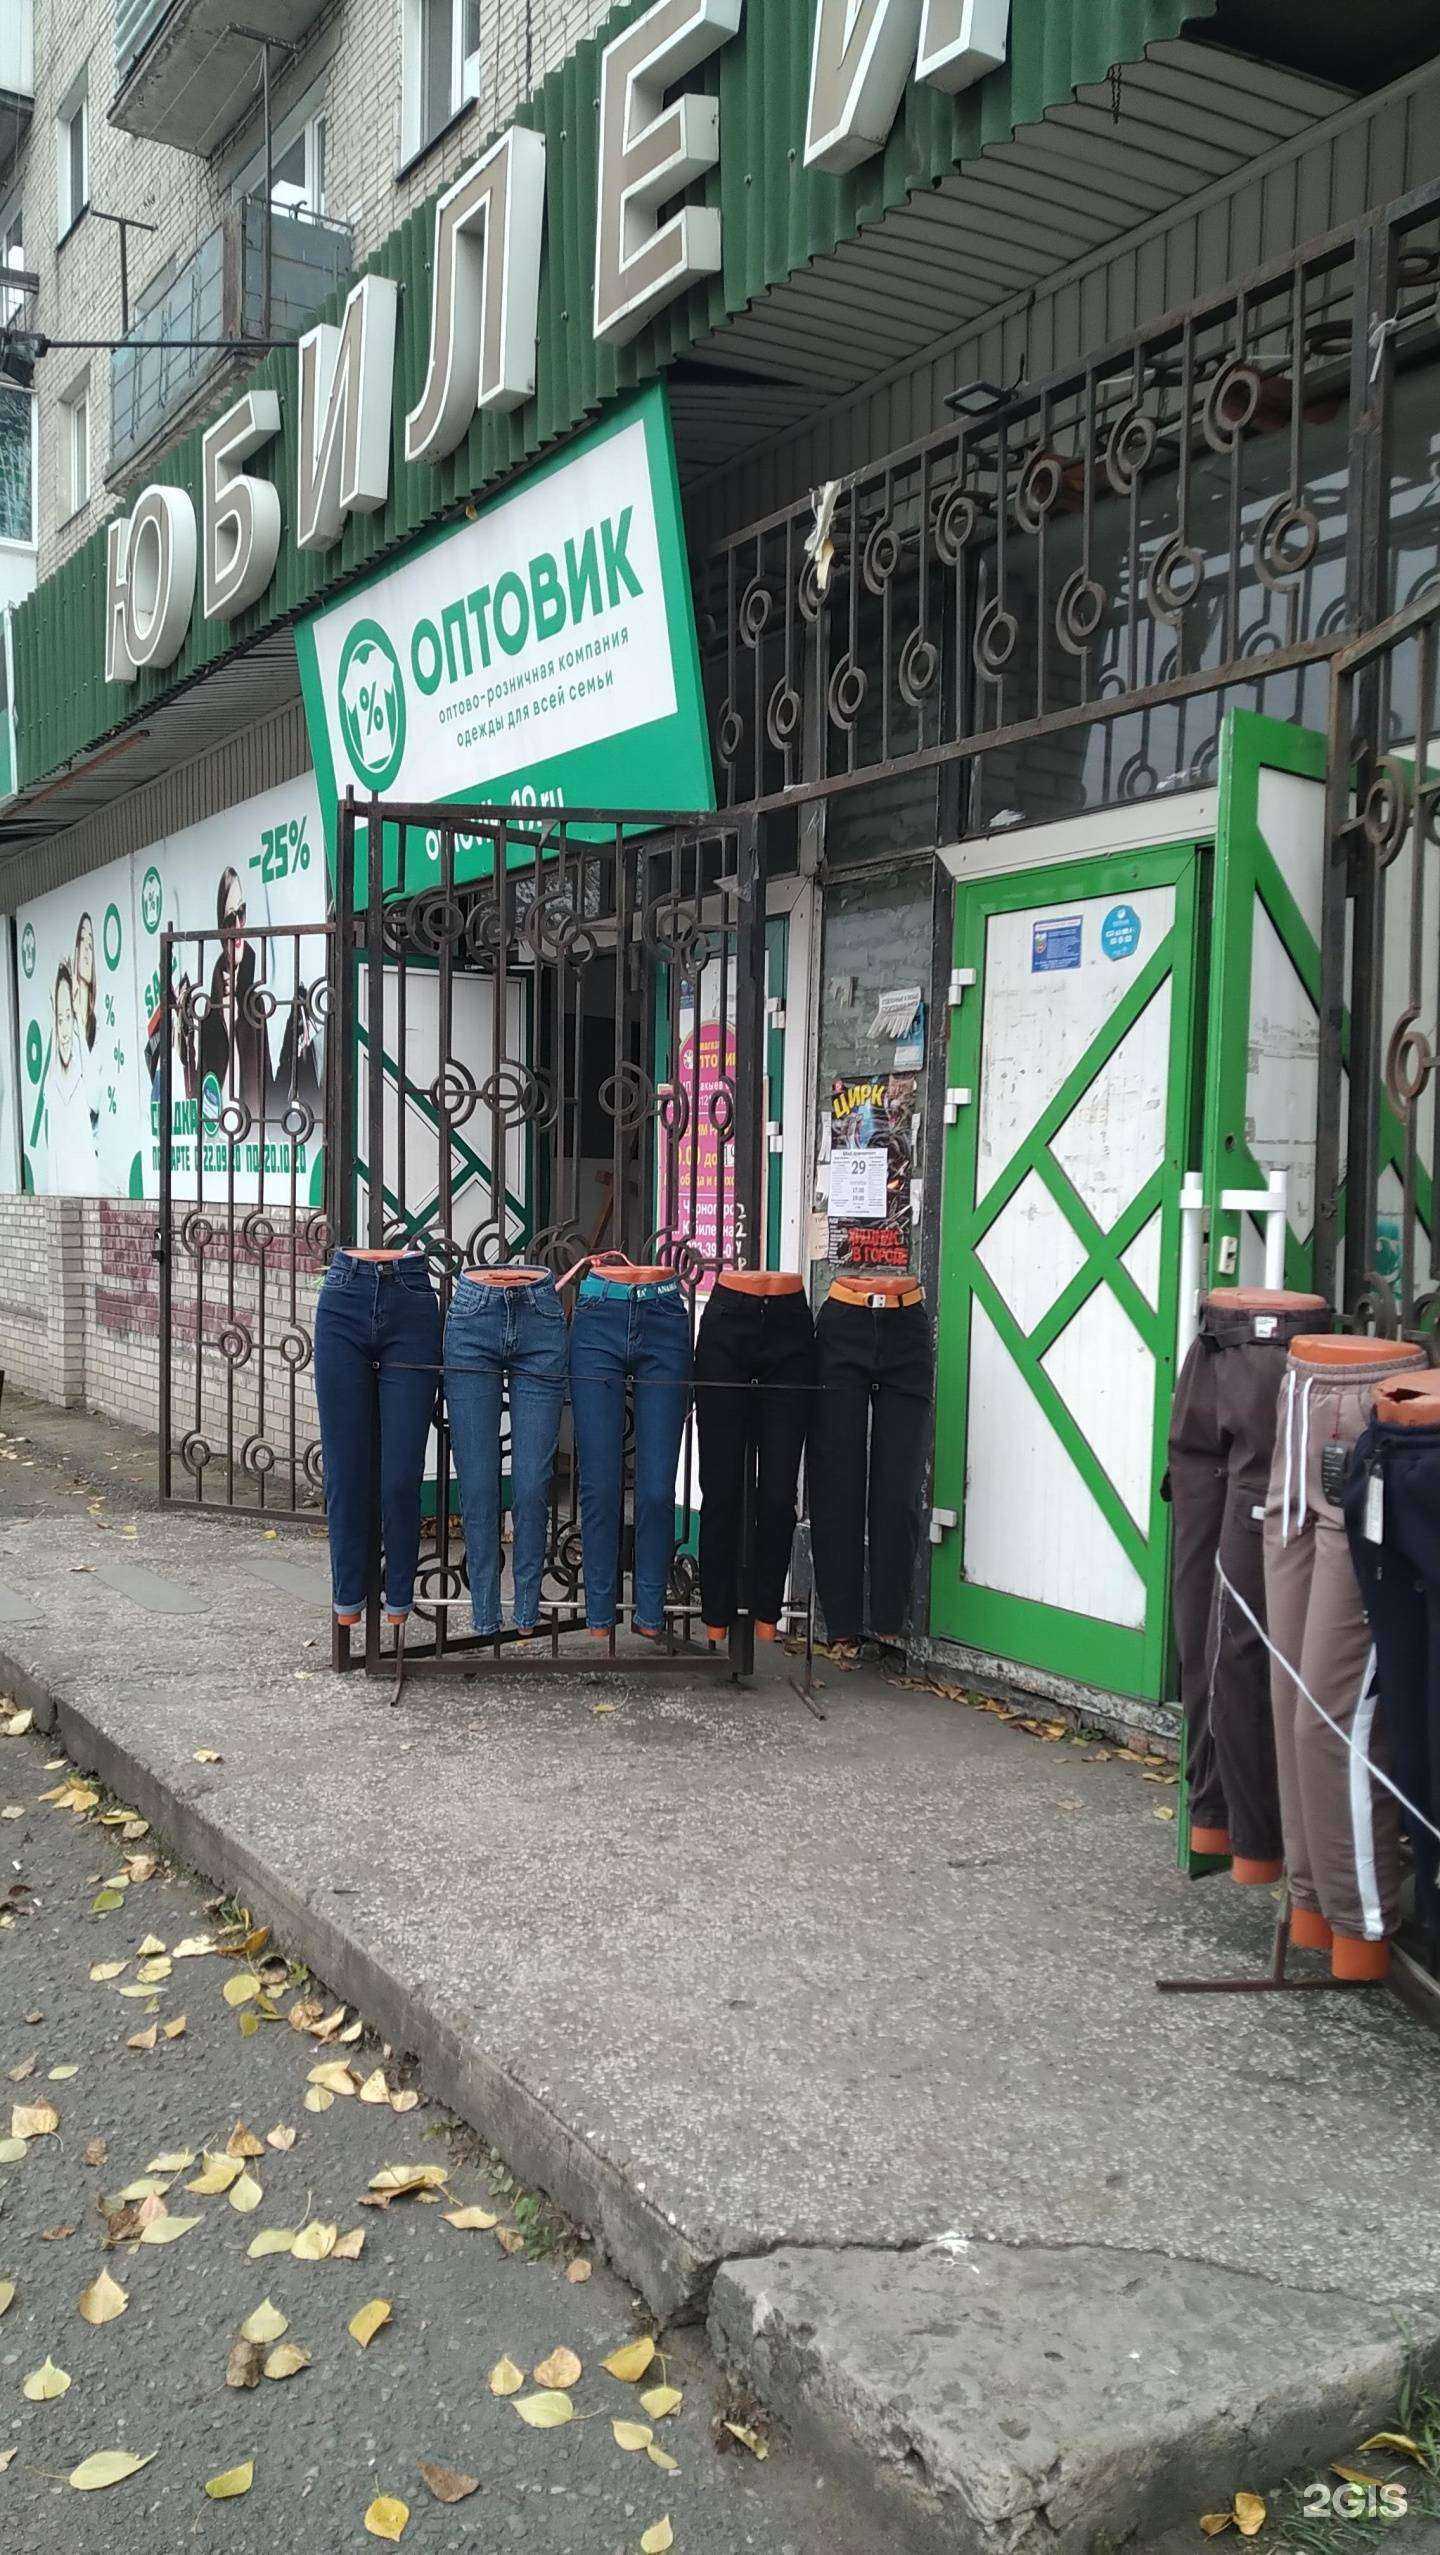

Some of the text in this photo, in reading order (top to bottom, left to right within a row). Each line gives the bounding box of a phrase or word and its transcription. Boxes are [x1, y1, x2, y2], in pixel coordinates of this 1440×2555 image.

[410, 505, 644, 696] ОПТОВИК
[438, 626, 630, 724] оптово-розничная компания
[456, 669, 614, 748] одежды для всей семьи
[248, 815, 311, 885] -25%
[151, 1101, 199, 1135] СДКА
[833, 1084, 885, 1119] ЦИРК
[168, 1145, 190, 1171] АРТЕ
[264, 1145, 307, 1173] 20.1020
[852, 1160, 866, 1175] 29
